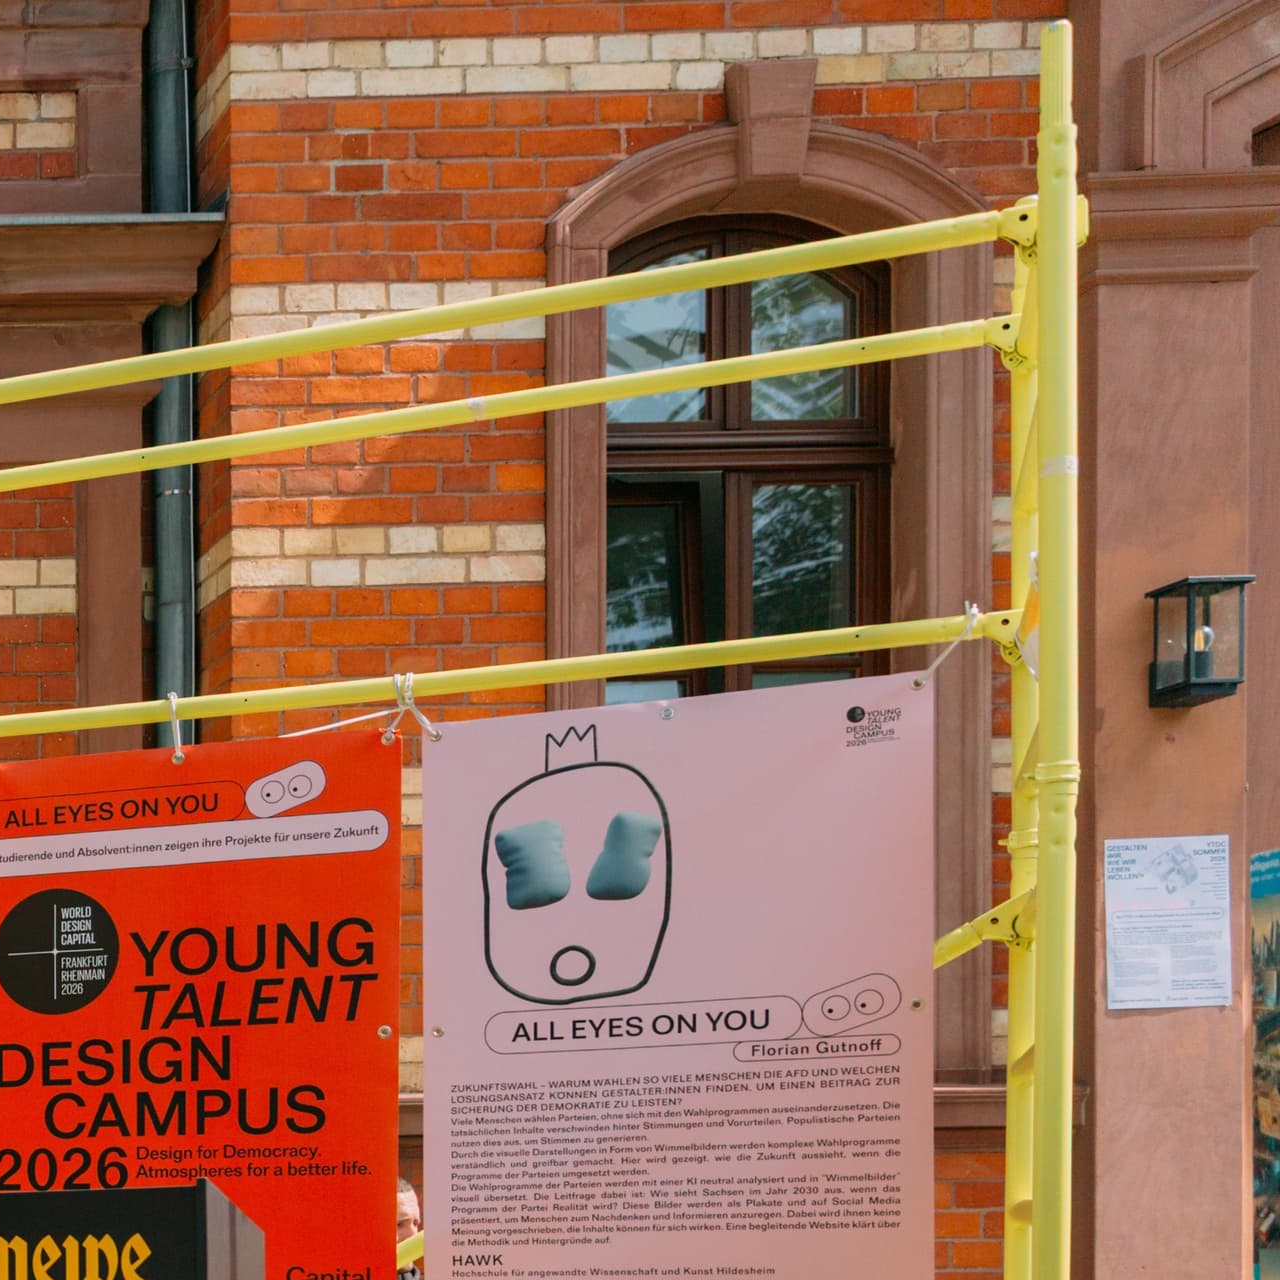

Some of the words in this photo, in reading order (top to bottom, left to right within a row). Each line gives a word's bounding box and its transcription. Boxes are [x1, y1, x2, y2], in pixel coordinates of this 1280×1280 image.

[4, 807, 48, 829] ALL
[53, 801, 114, 825] EYES
[120, 797, 159, 819] ON
[165, 792, 219, 815] YOU
[55, 847, 75, 860] und
[76, 844, 162, 857] Absolvent:innen
[164, 841, 200, 853] zeigen
[201, 837, 223, 848] ihre
[224, 833, 272, 848] Projekte
[274, 832, 291, 843] für
[292, 831, 331, 842] unsere
[333, 825, 379, 839] Zukunft
[60, 906, 92, 919] WORLD
[60, 919, 92, 933] DESIGN
[60, 932, 97, 946] CAPITAL
[129, 917, 374, 977] YOUNG
[61, 954, 108, 969] FRANKFURT
[61, 968, 106, 982] RHEINMAIN
[61, 982, 84, 996] 2026
[134, 973, 379, 1031] TALENT
[511, 1021, 565, 1043] ALL
[572, 1016, 644, 1040] EYES
[651, 1013, 697, 1036] ON
[705, 1008, 770, 1032] YOU
[751, 1044, 810, 1057] Florian
[815, 1038, 887, 1057] Gutnoff
[44, 1084, 326, 1140] CAMPUS
[136, 1146, 193, 1163] Design
[196, 1144, 219, 1160] for
[223, 1144, 322, 1161] Democracy.
[135, 1162, 243, 1180] Atmospheres
[246, 1162, 270, 1177] for
[273, 1166, 283, 1177] a
[287, 1161, 339, 1177] better
[342, 1160, 372, 1176] life.
[452, 1254, 503, 1267] HAWK
